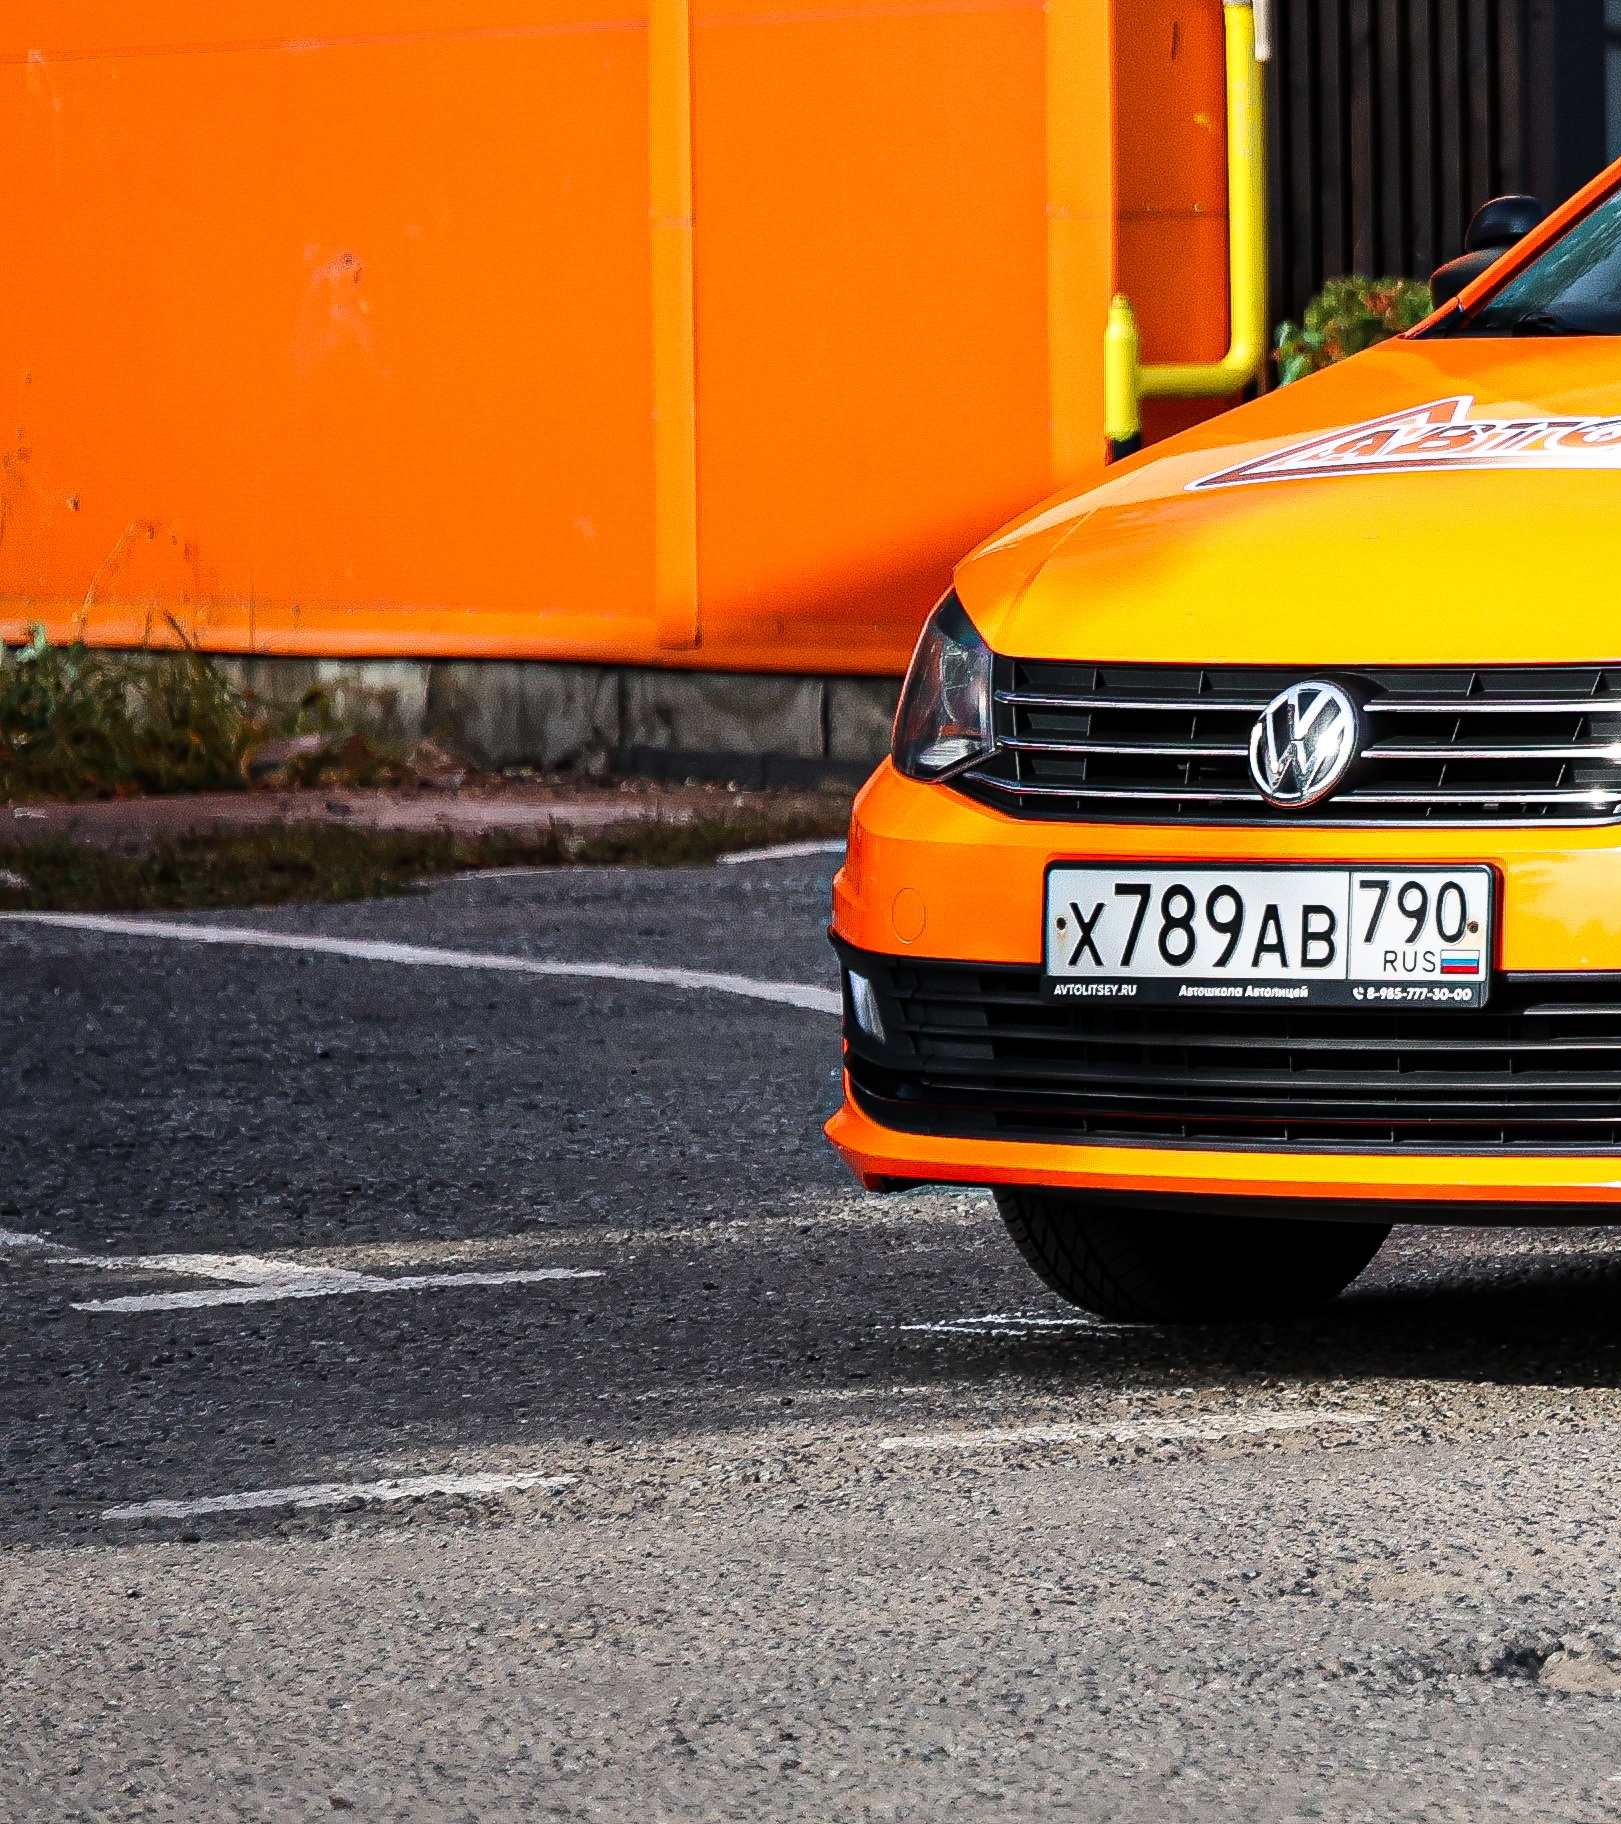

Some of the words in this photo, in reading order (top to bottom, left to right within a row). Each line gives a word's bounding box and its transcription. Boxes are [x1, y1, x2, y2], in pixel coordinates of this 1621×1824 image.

[1067, 883, 1338, 969] Х789АВ
[1358, 879, 1468, 946] 790
[1383, 949, 1437, 974] RUS
[1053, 983, 1138, 997] AVTOLITSEY.RU
[1178, 983, 1243, 998] Автошкола
[1244, 984, 1309, 999] Автолицей
[1366, 987, 1472, 1001] 8-985-777-30-00
